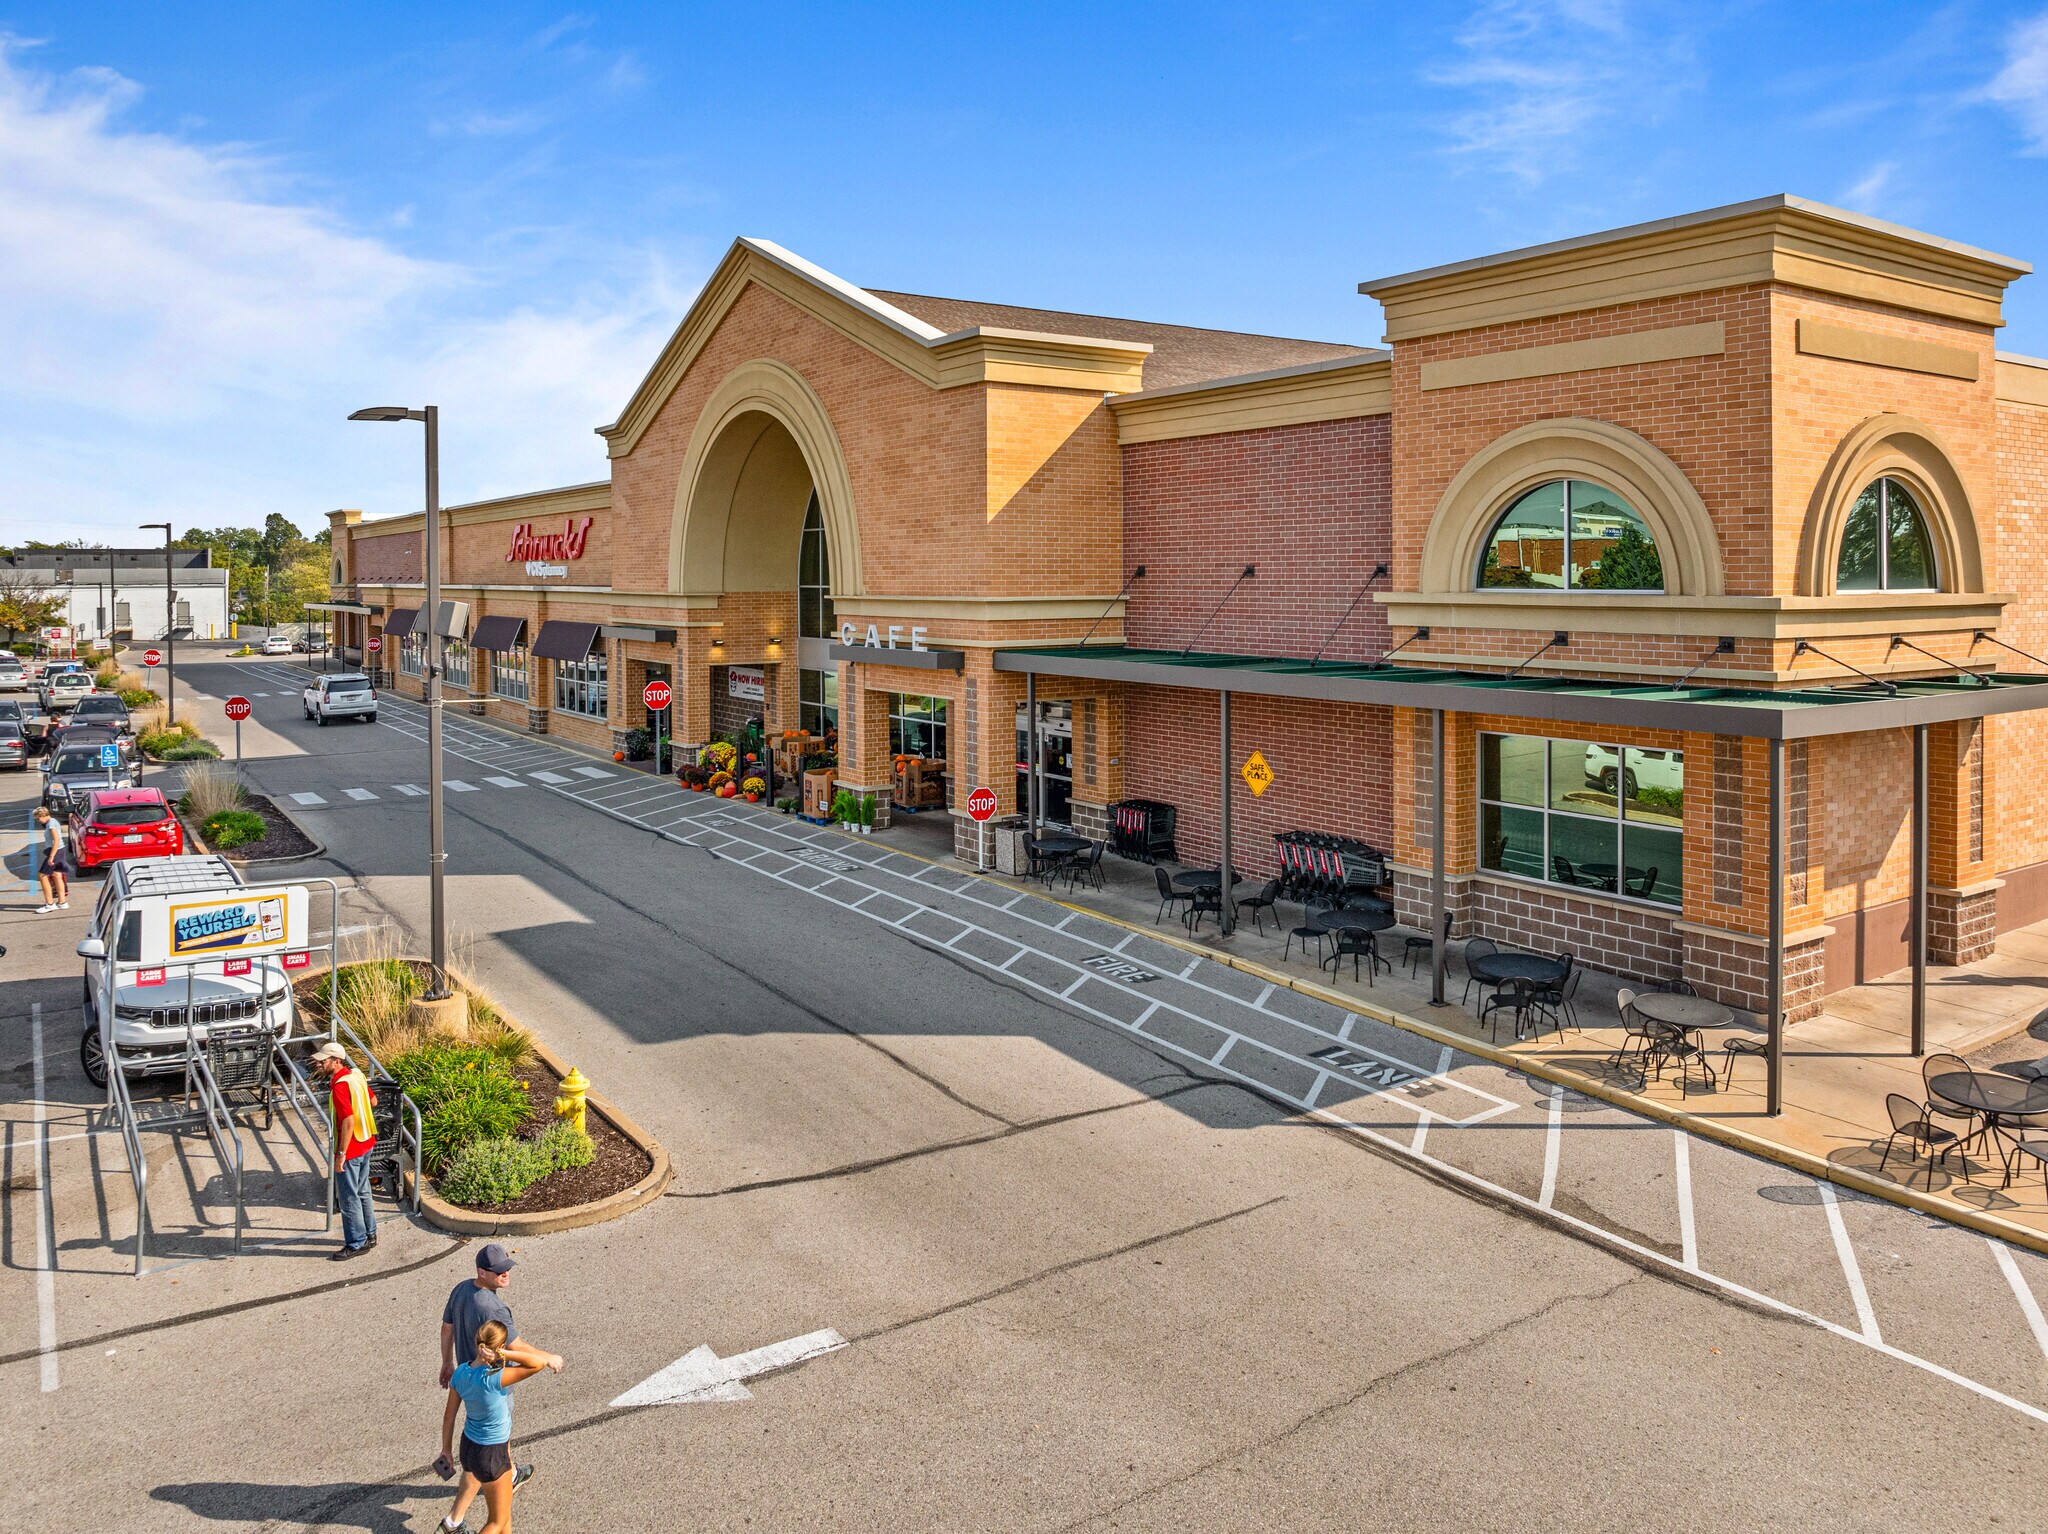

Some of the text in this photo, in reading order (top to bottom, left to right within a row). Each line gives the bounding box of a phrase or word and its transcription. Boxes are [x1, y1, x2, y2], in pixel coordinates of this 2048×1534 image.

[841, 622, 928, 652] CAFE
[737, 674, 750, 684] NOW
[645, 690, 670, 701] STOP
[226, 703, 250, 714] STOP
[1250, 763, 1264, 772] SAFE
[1246, 771, 1268, 781] PLACE
[969, 797, 995, 812] STOP
[178, 905, 245, 930] REWARD
[178, 914, 257, 940] YOURSELF
[788, 848, 860, 871] PARKING
[1083, 956, 1154, 982] FIRE
[1318, 1050, 1433, 1093] LANE
